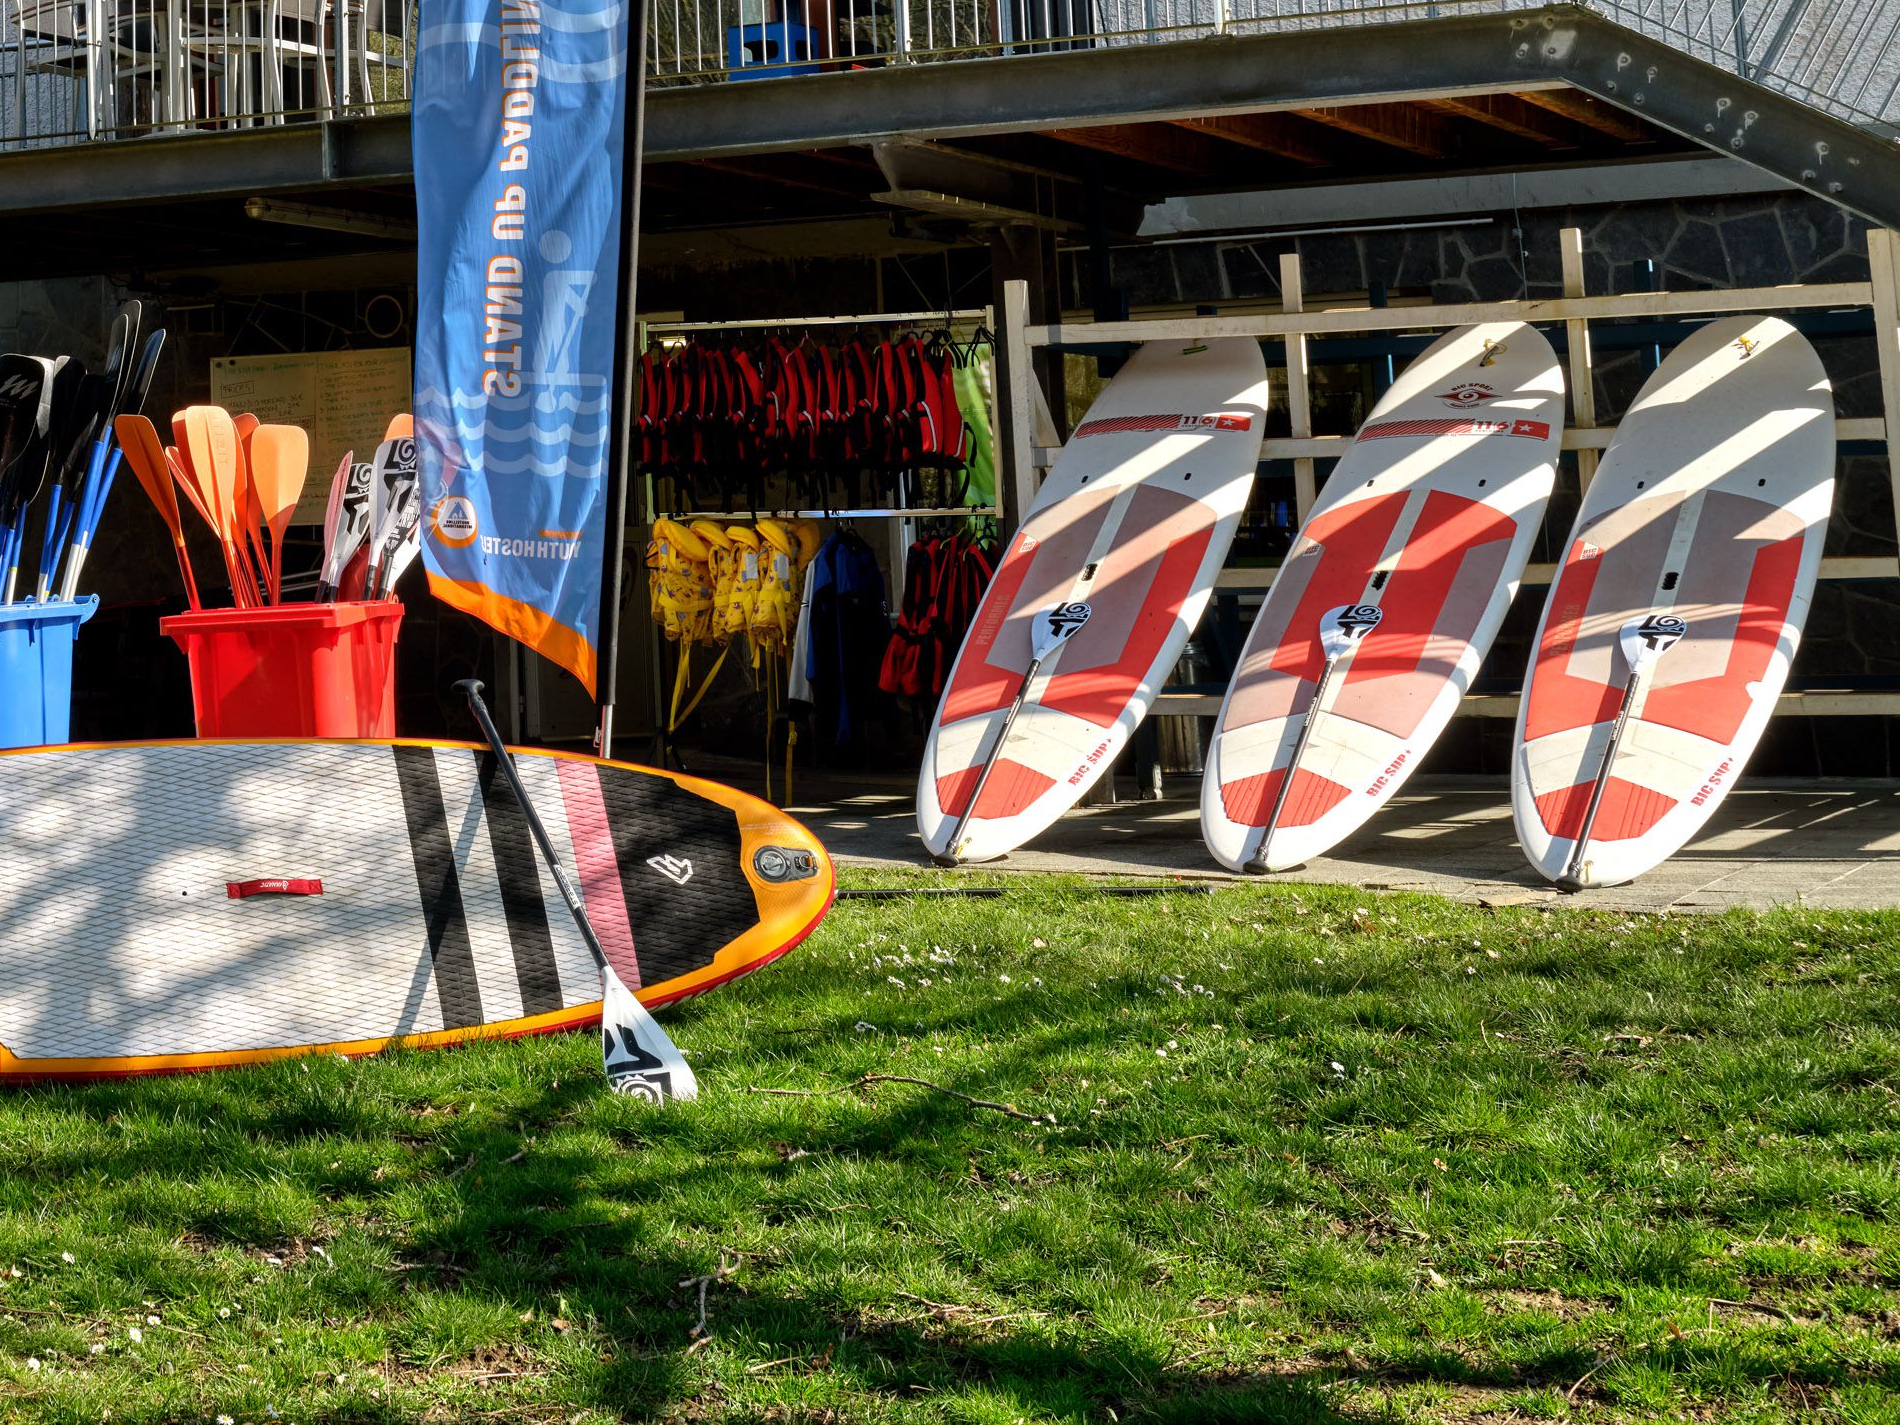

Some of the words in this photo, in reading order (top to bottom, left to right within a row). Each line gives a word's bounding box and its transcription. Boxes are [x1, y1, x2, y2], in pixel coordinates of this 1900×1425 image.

[1451, 383, 1467, 392] BIC
[1468, 382, 1494, 392] SPORT
[975, 594, 1011, 645] PERFORMER
[1067, 765, 1090, 786] BIC
[1086, 743, 1108, 764] SUP
[1365, 775, 1389, 797] BIC
[1384, 754, 1407, 777] SUP
[1690, 785, 1714, 806] BIC
[1708, 761, 1731, 786] SUP
